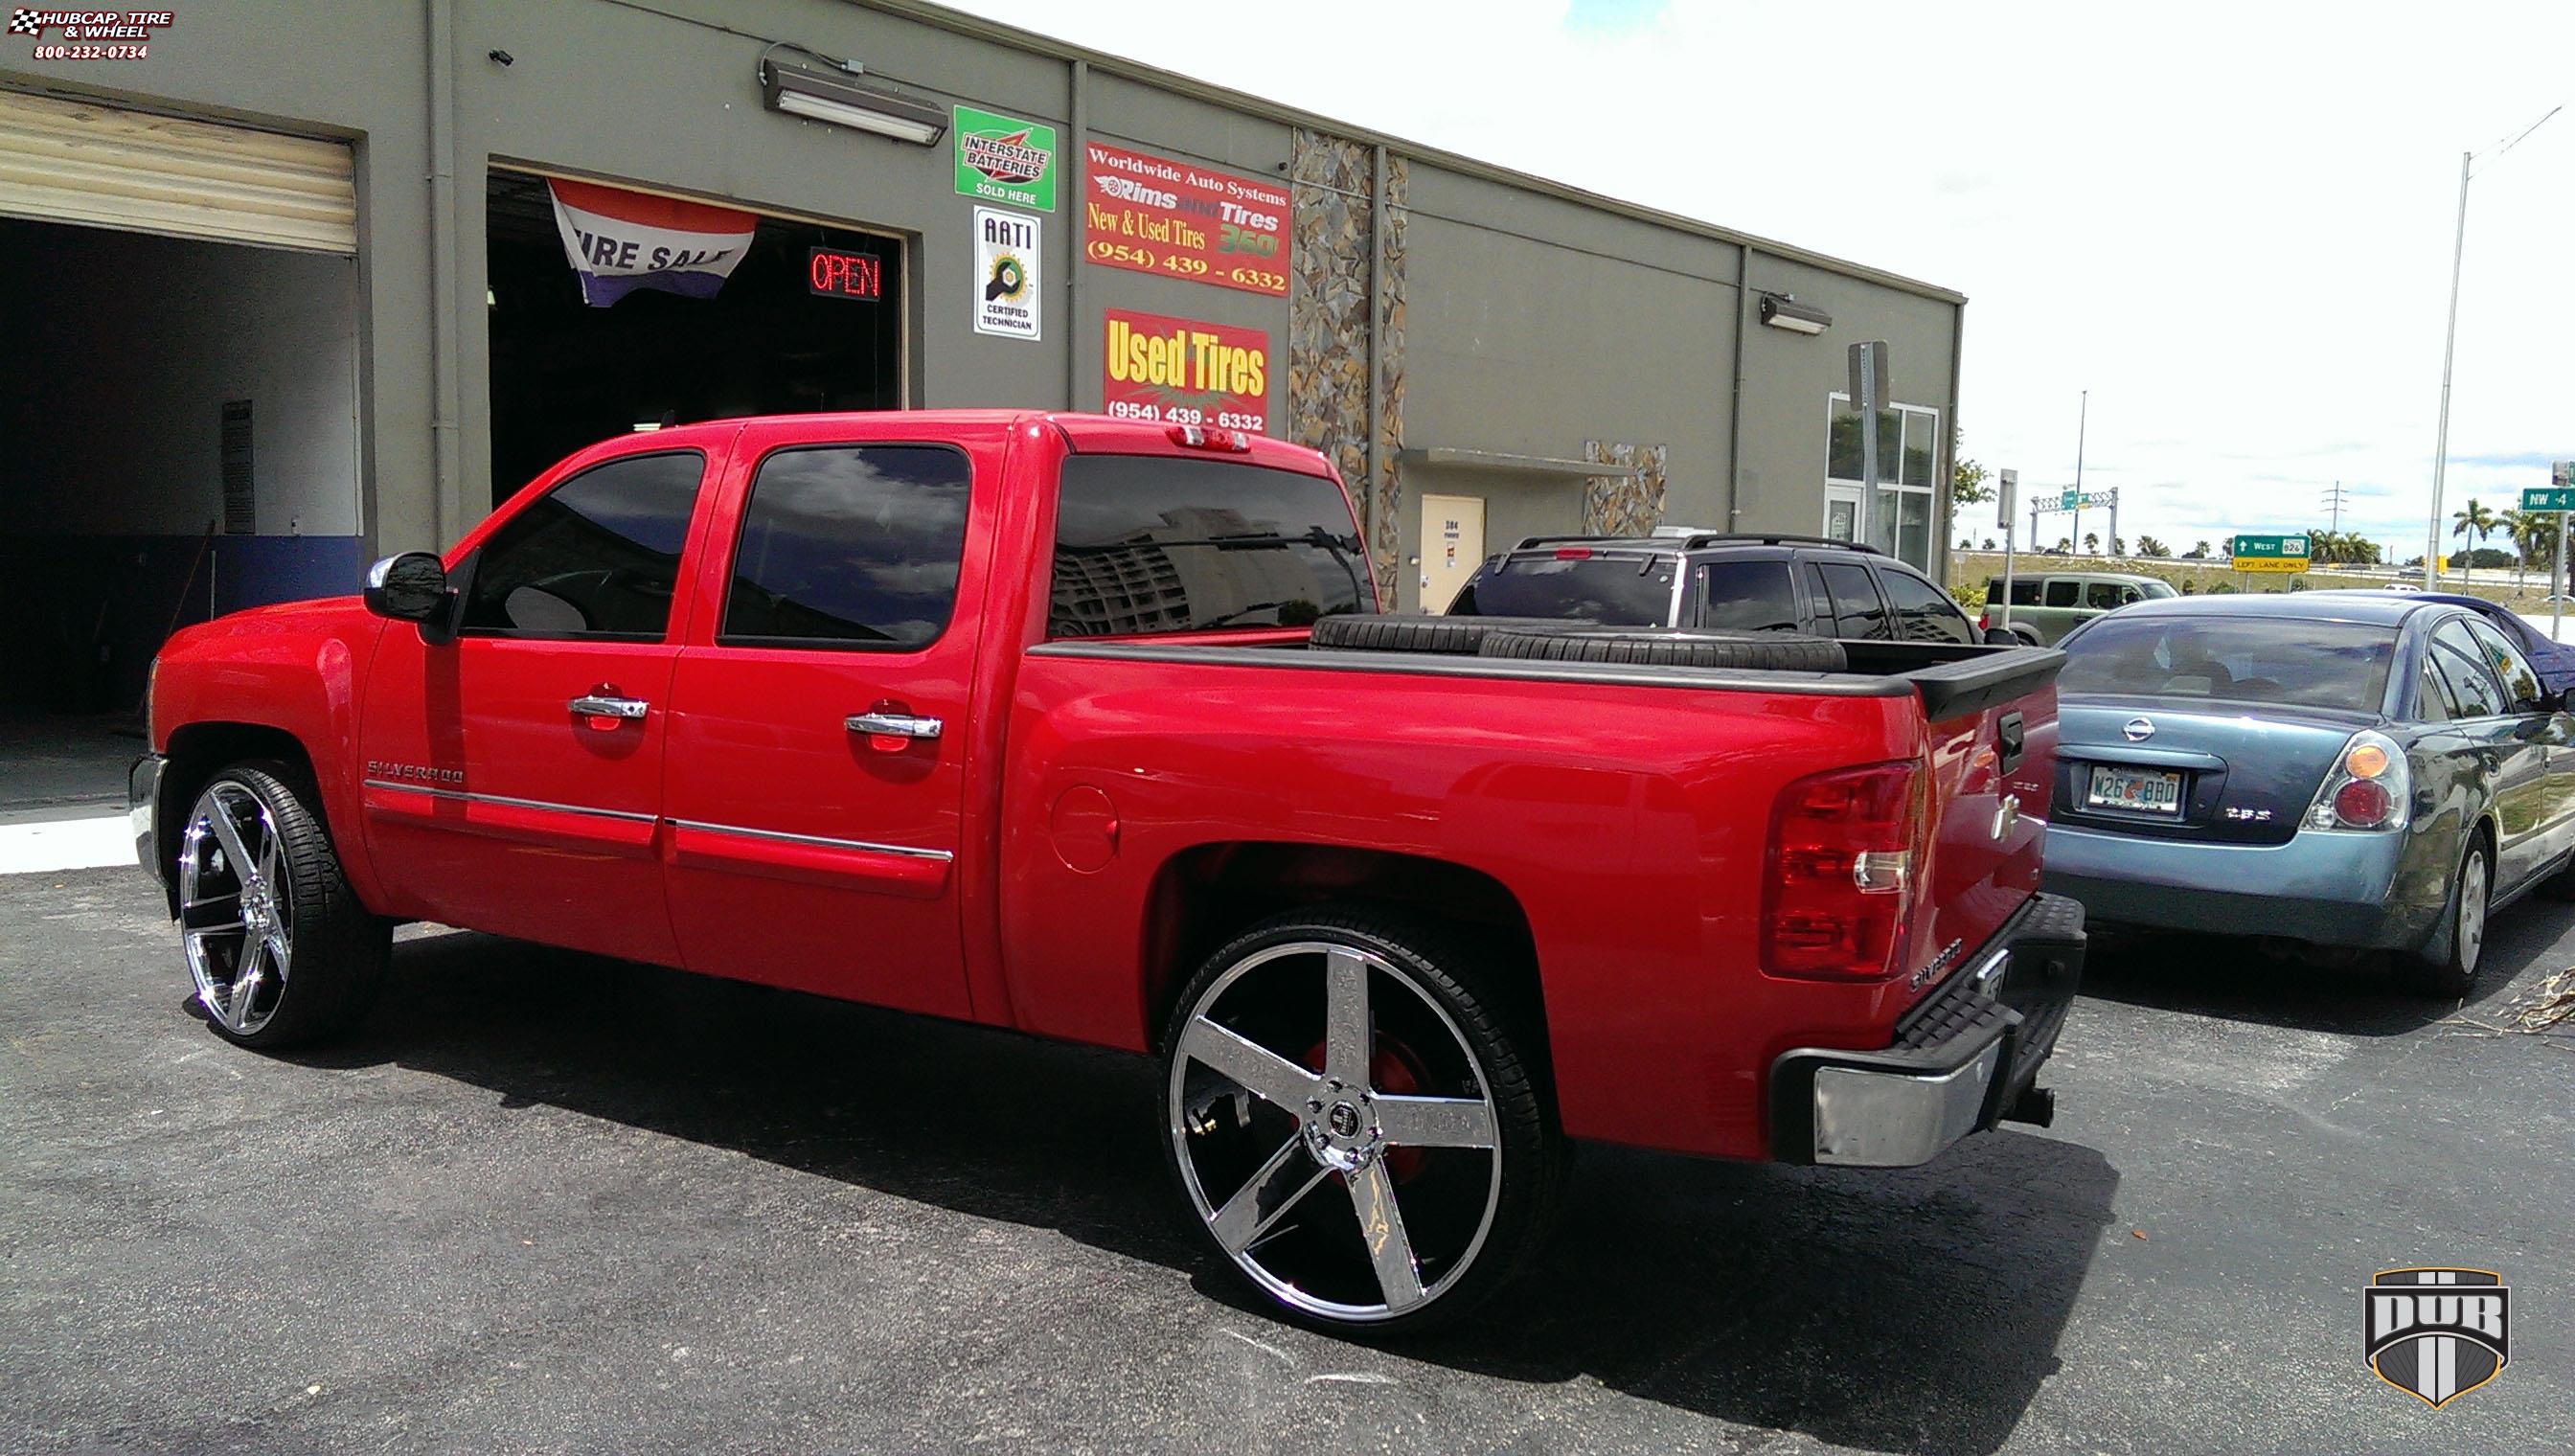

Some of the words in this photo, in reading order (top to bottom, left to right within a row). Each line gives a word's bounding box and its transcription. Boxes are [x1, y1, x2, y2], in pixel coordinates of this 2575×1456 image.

[965, 136, 1046, 165] INTERSTATE
[967, 152, 1040, 177] BATTERIES
[1088, 148, 1181, 182] Worldwide
[1185, 171, 1224, 193] Auto
[1227, 181, 1287, 207] Systems
[976, 183, 1005, 197] SOLD
[1008, 190, 1037, 204] HERE
[1119, 179, 1177, 210] Rims
[1219, 201, 1279, 231] Tires
[985, 217, 1032, 249] AATI
[1088, 202, 1118, 233] New
[1122, 209, 1134, 237] &
[1138, 213, 1170, 243] Used
[1173, 219, 1205, 251] Tires
[812, 254, 879, 297] OPEN
[1087, 240, 1155, 269] (954)
[1162, 254, 1208, 276] 439
[1231, 267, 1286, 291] 6332
[983, 315, 1033, 330] TECHNICIAN
[987, 304, 1029, 319] CERTIFIED
[1108, 319, 1186, 388] Used
[1192, 331, 1265, 398] Tires
[1108, 400, 1160, 421] (954)
[1165, 406, 1201, 424] 439
[1218, 411, 1264, 431] 6332
[2529, 492, 2549, 507] NW
[2284, 543, 2300, 553] 826
[2236, 560, 2254, 569] LEFT
[2258, 560, 2280, 569] LANE
[2283, 560, 2305, 569] ONLY
[367, 760, 465, 784] SILVERADO
